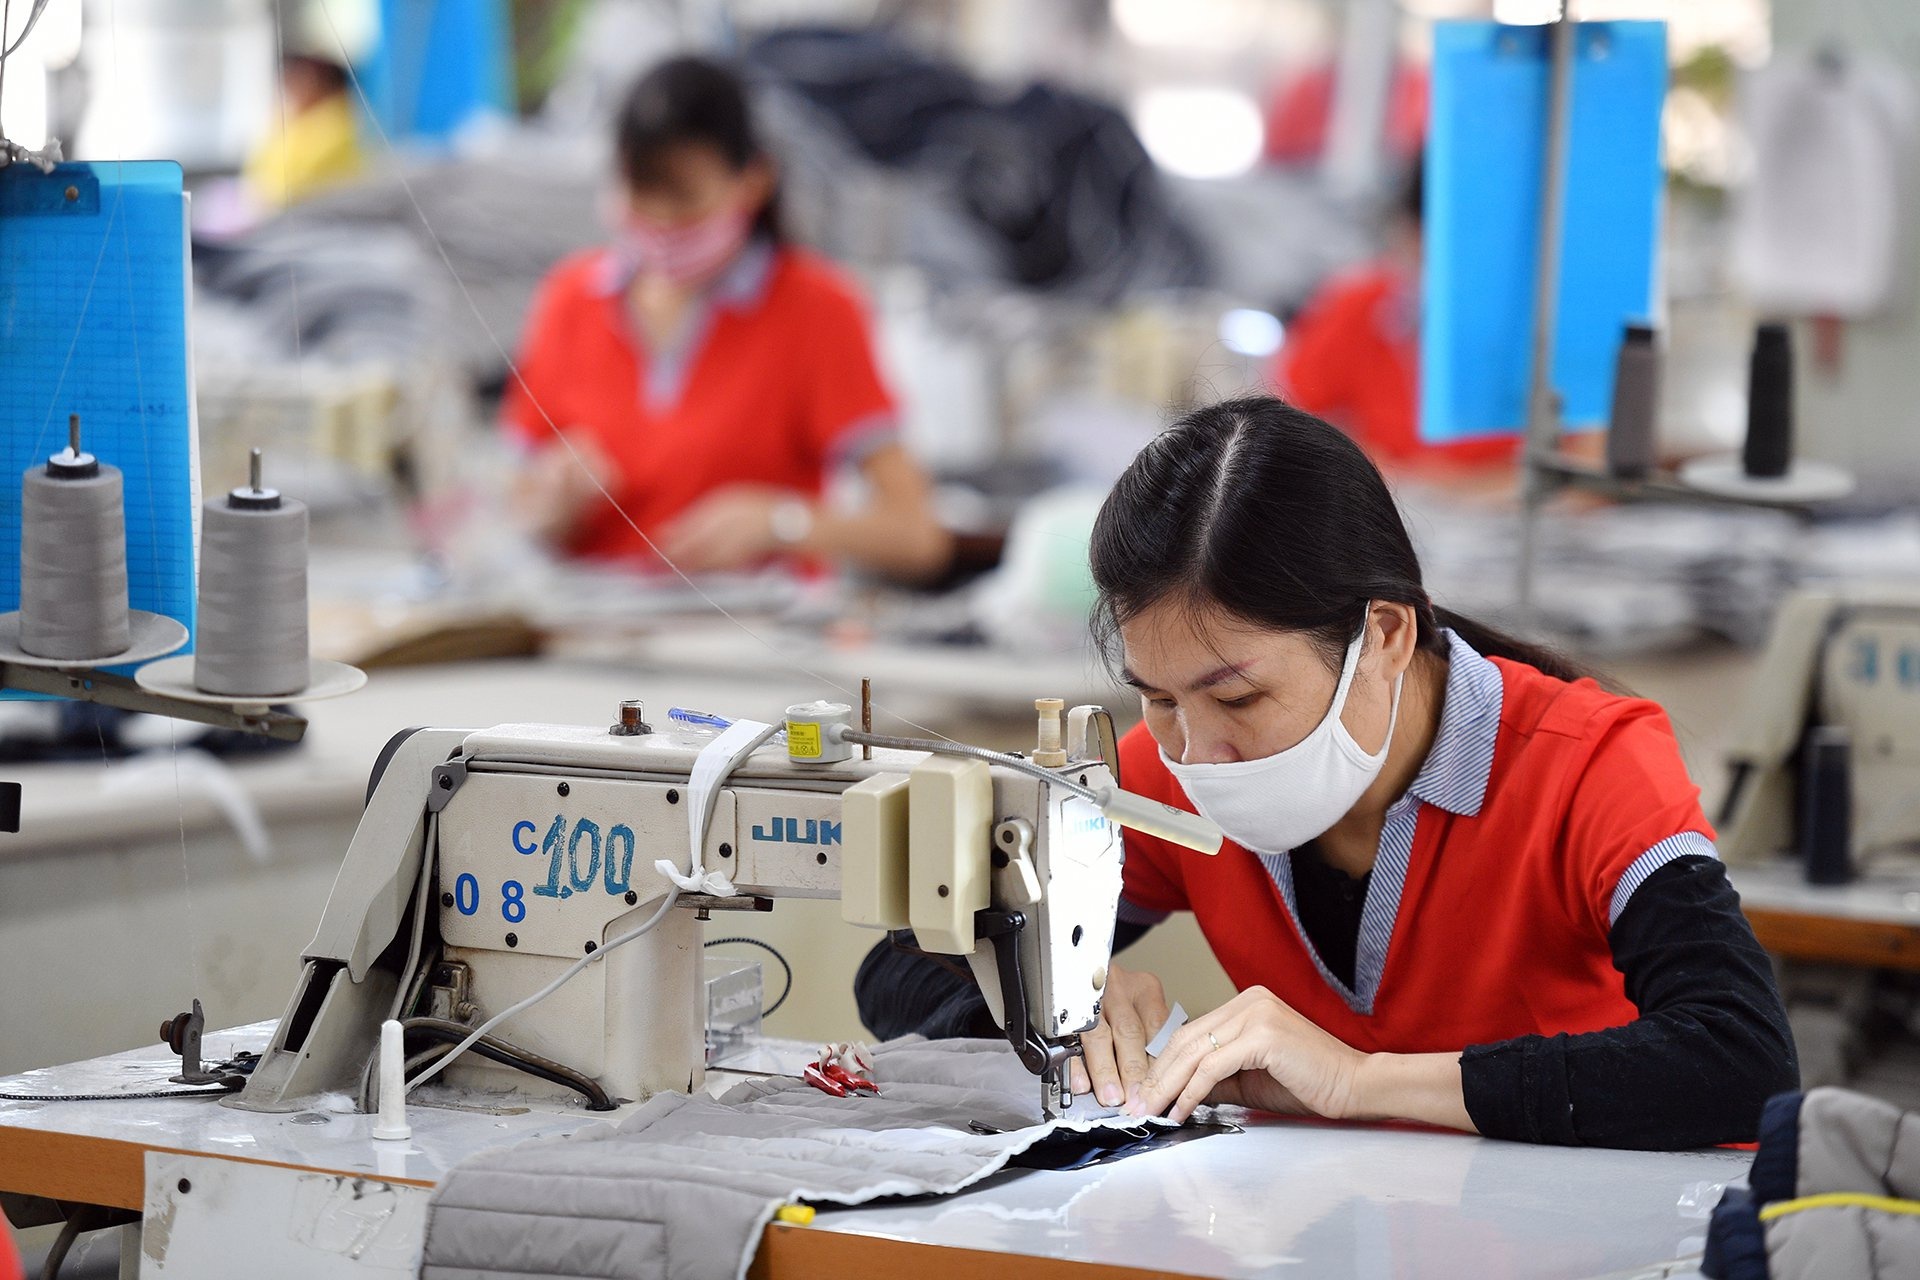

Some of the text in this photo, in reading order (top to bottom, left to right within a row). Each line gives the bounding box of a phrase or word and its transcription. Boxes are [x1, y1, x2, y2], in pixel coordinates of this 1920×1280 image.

[512, 820, 538, 855] C
[752, 816, 842, 846] JUK
[532, 814, 635, 899] 100
